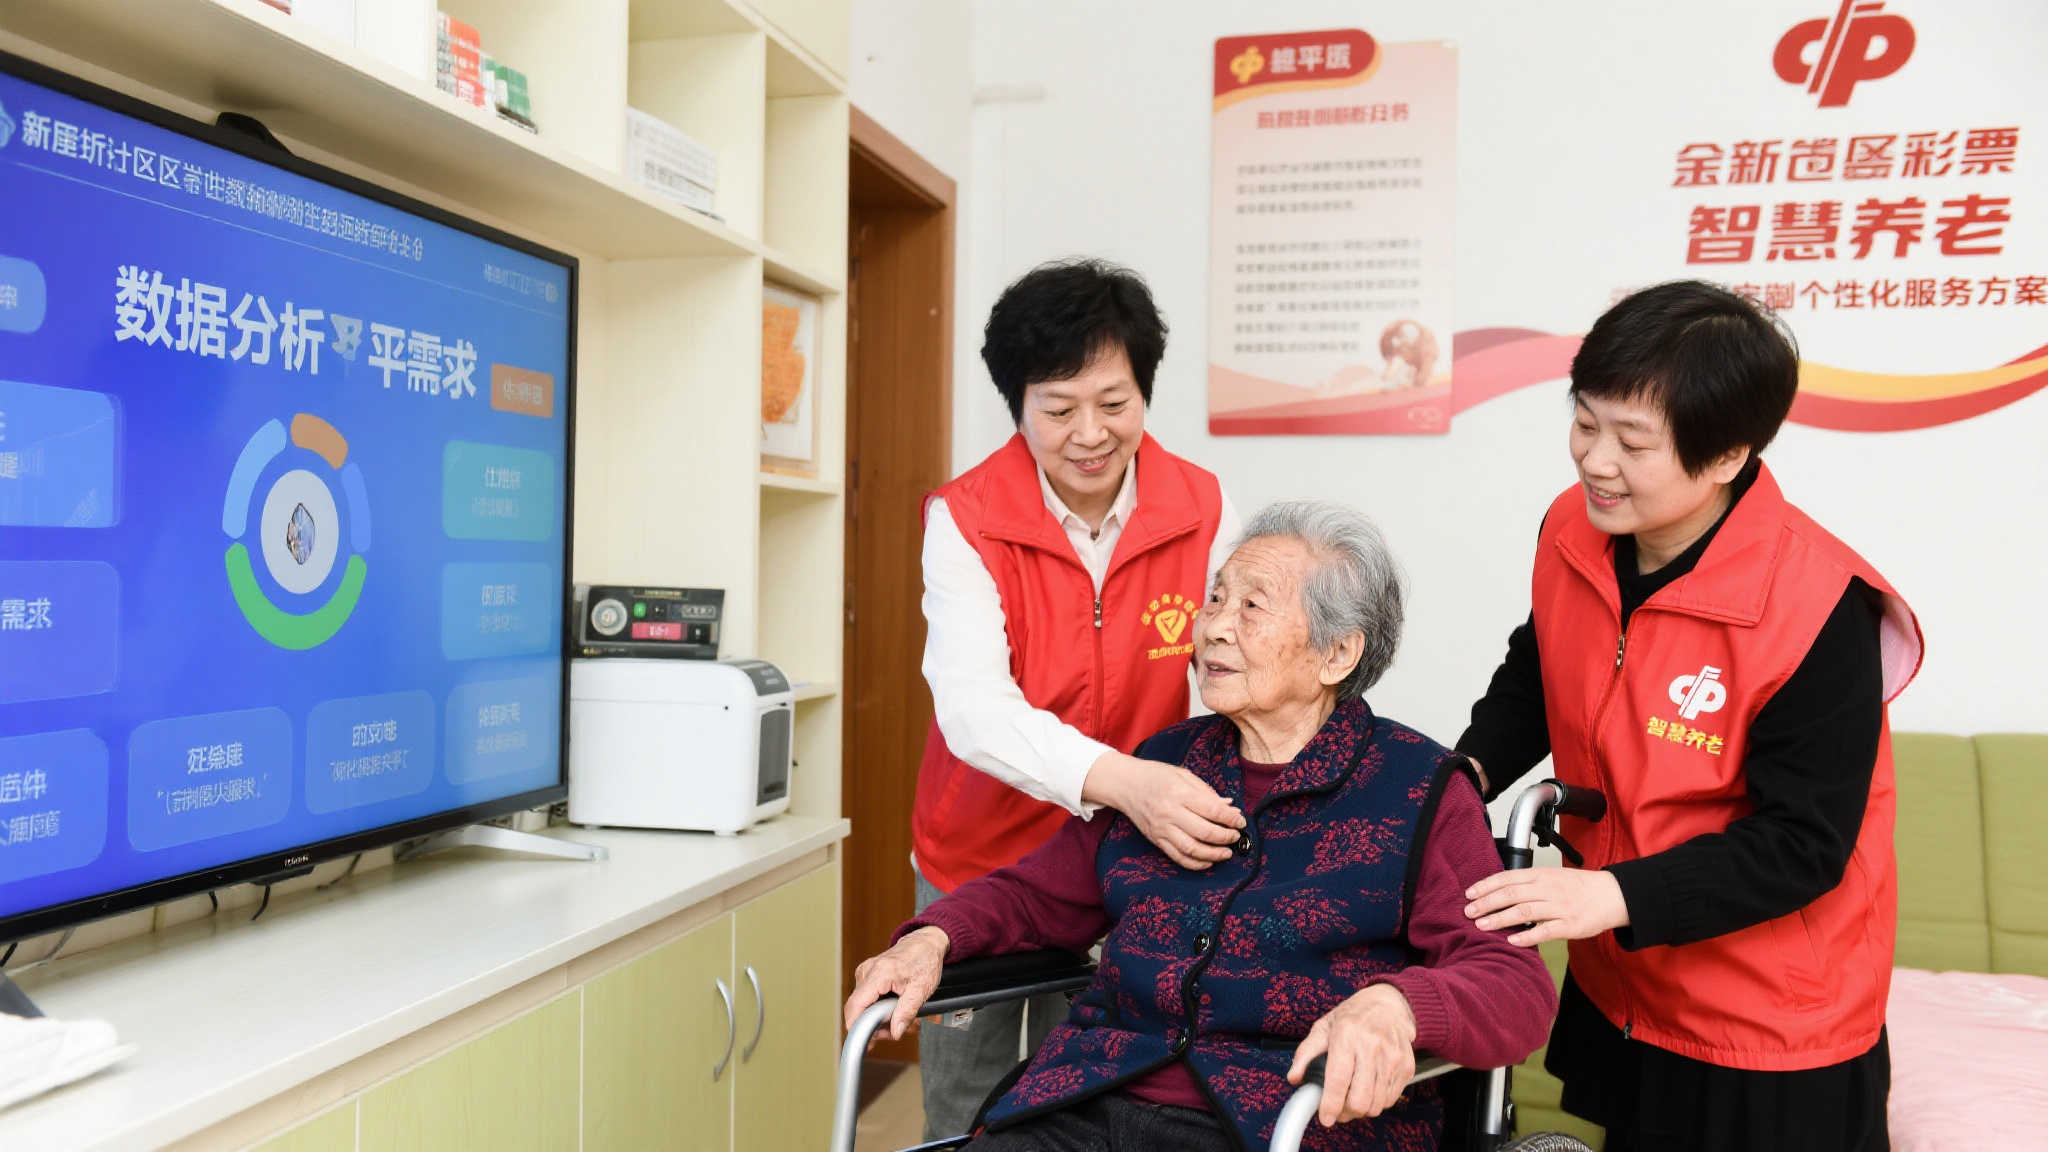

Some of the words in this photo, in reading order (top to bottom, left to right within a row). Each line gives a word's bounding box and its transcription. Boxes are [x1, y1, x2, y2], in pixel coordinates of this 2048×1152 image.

[1686, 193, 2012, 265] 智慧养老
[114, 264, 478, 400] 数据分析平需求
